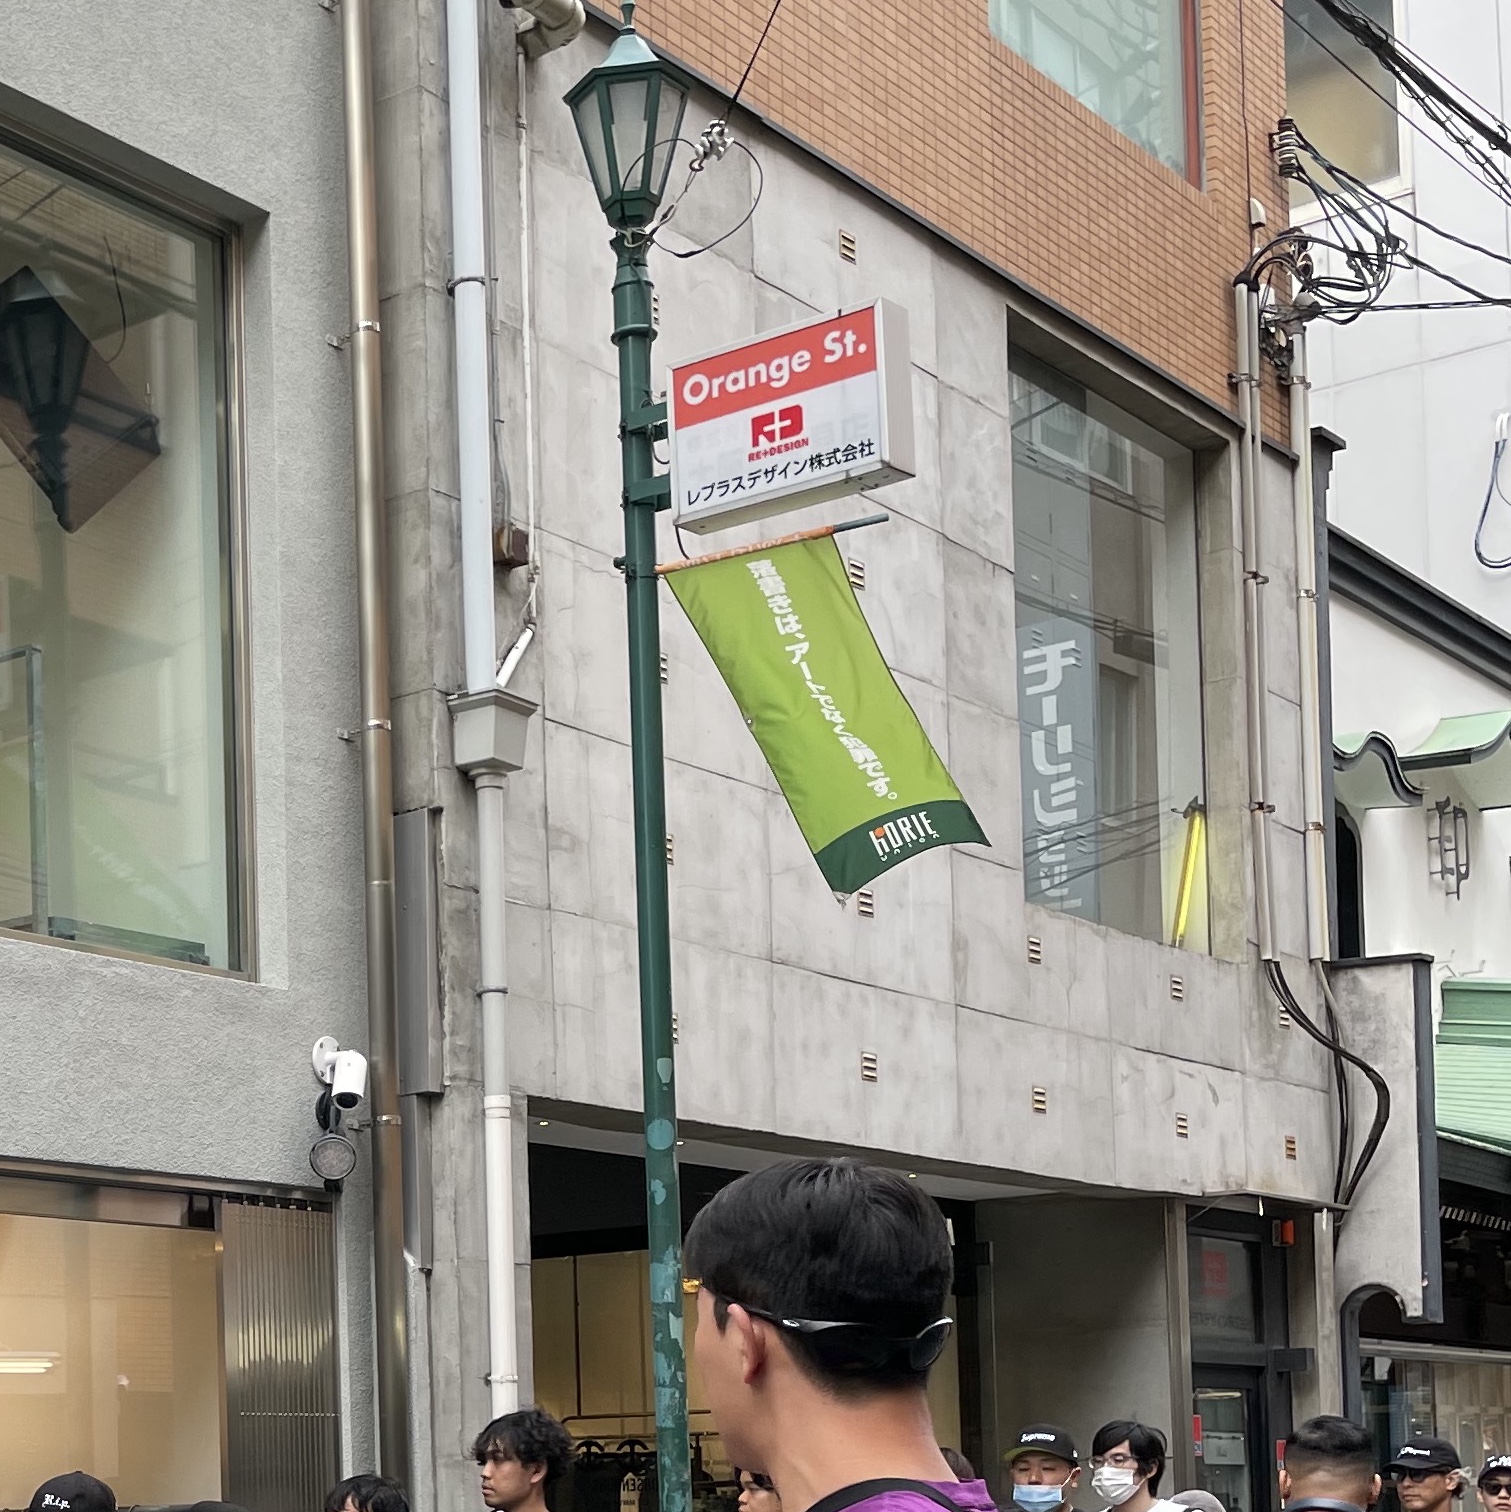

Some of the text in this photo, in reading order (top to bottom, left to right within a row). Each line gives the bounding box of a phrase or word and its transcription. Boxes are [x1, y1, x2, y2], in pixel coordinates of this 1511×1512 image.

[682, 329, 867, 405] Orange St.
[687, 438, 875, 506] レプラスデザイン株式会社
